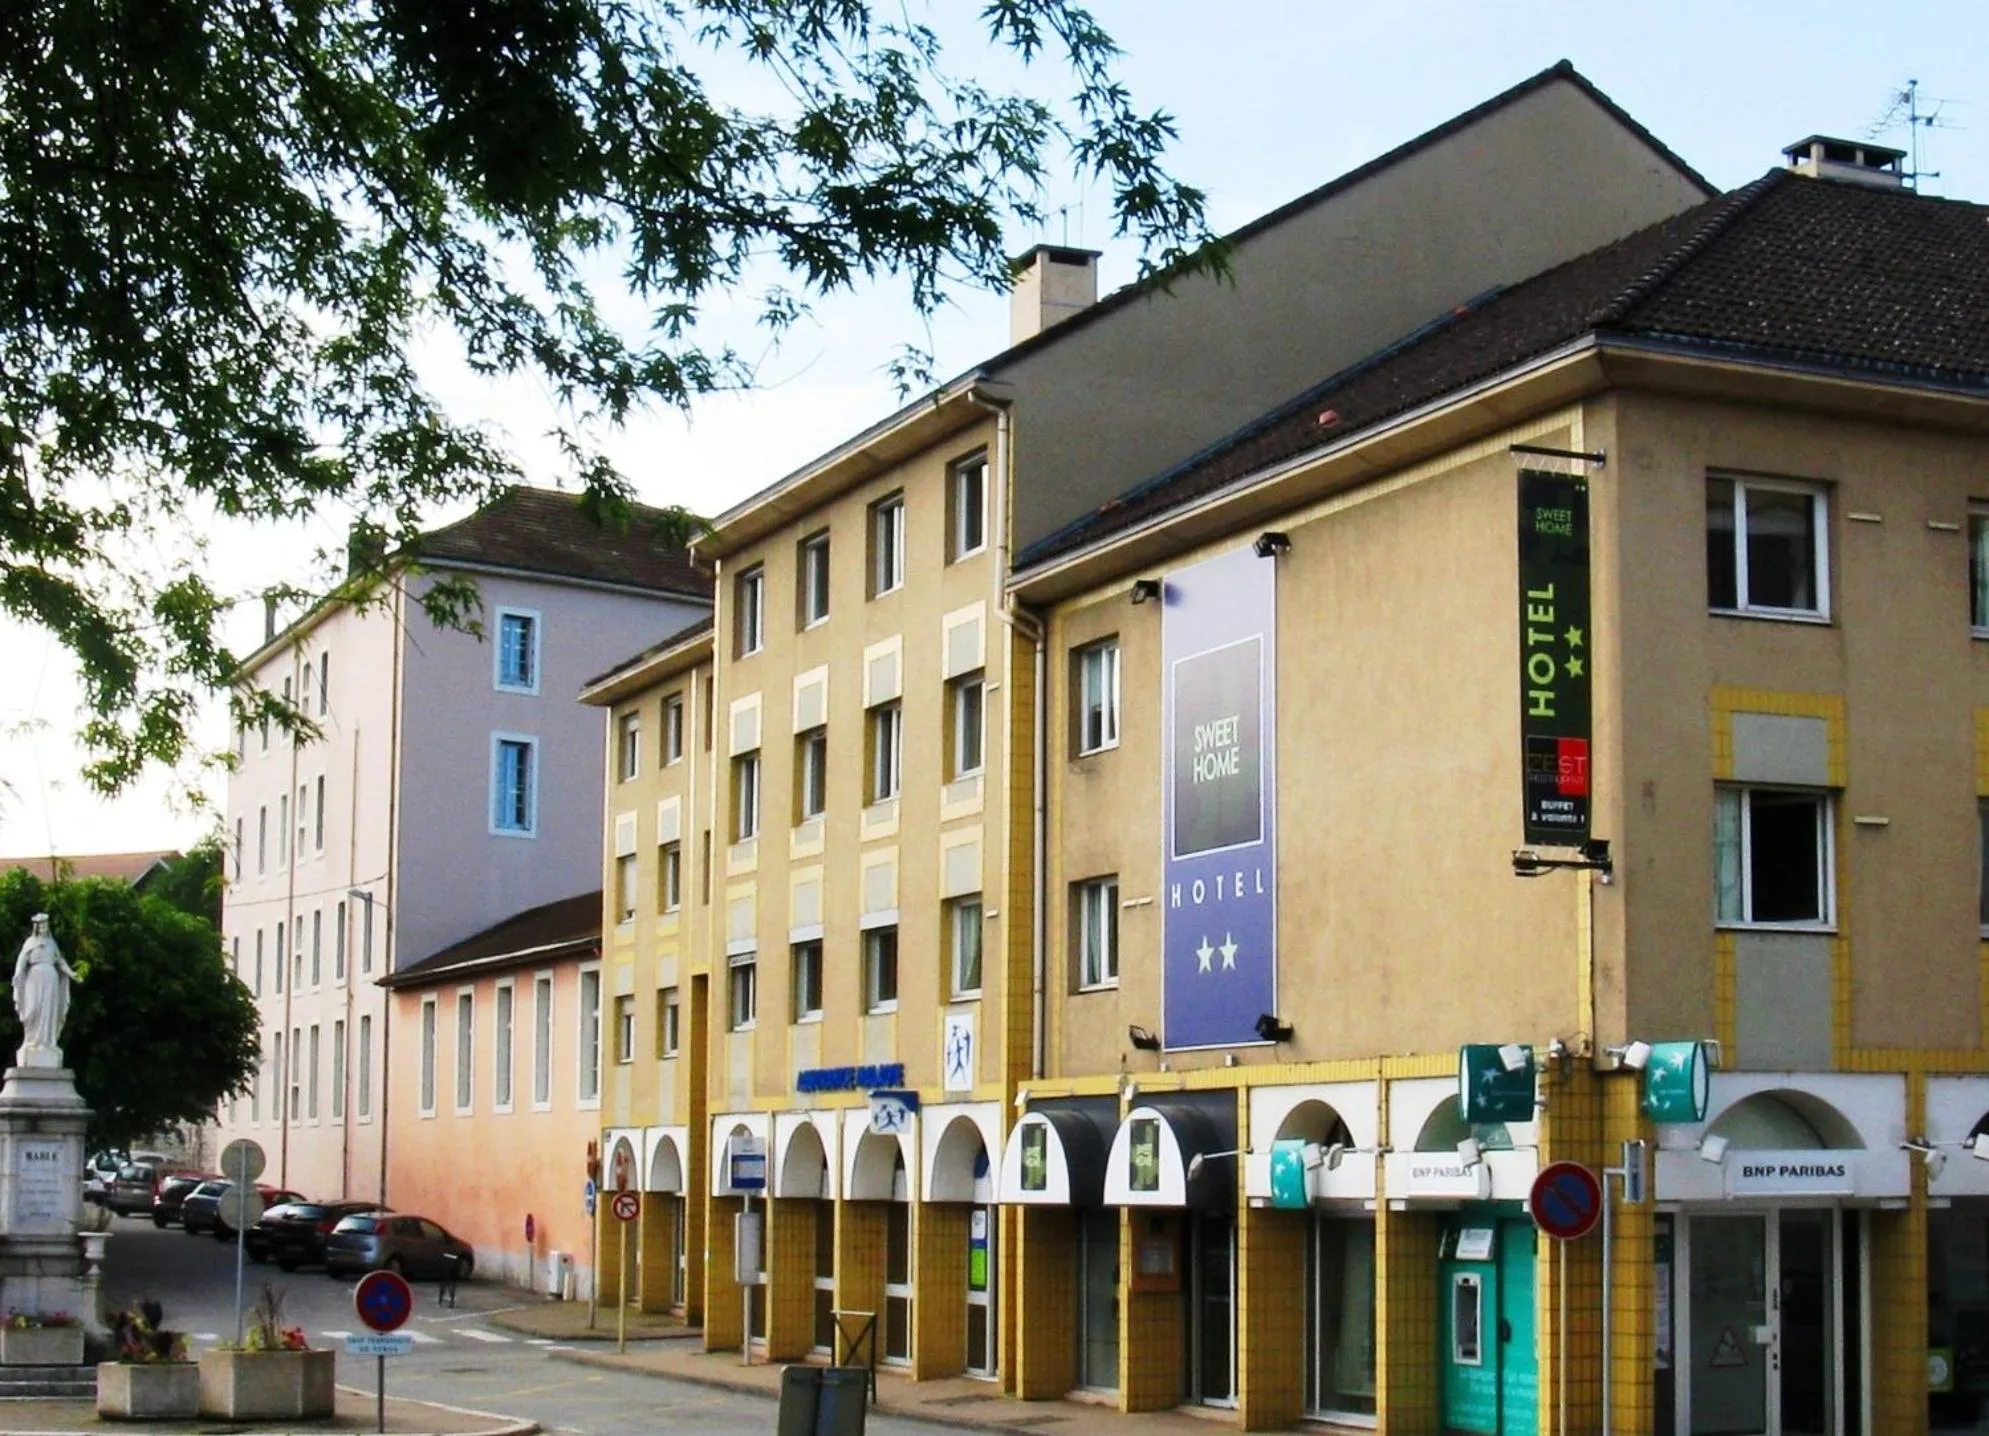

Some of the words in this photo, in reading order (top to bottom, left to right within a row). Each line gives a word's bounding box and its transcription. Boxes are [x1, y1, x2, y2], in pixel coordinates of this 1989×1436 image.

[1535, 507, 1572, 521] SWEET
[1535, 520, 1573, 537] HOME
[1527, 583, 1555, 717] HOTEL
[1194, 715, 1239, 753] SWEET
[1193, 746, 1240, 785] HOME
[1171, 868, 1264, 909] HOTEL
[1743, 1166, 1776, 1178] BNP
[1779, 1165, 1846, 1177] PARIBAS
